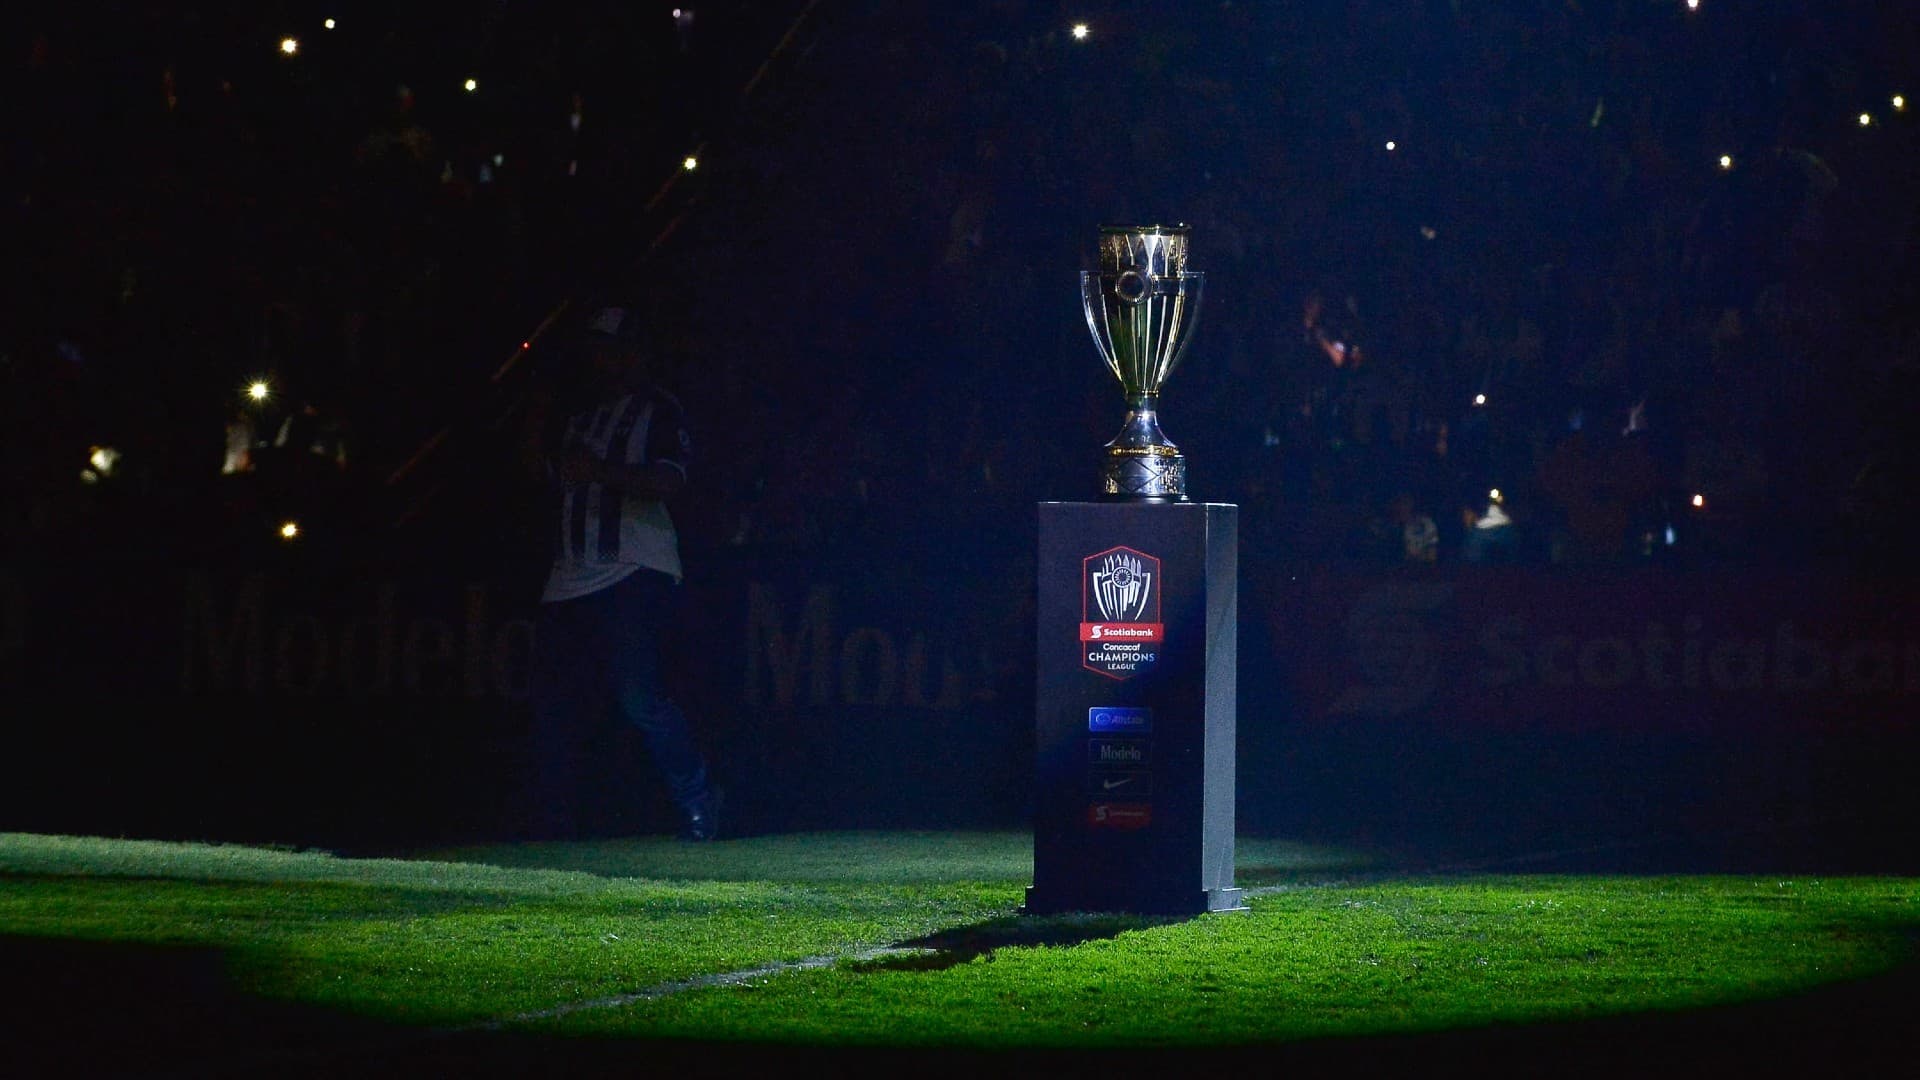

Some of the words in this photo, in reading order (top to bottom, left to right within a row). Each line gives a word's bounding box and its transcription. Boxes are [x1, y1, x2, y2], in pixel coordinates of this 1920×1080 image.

[1103, 628, 1154, 637] Scotiabank
[1102, 643, 1141, 651] Concacaf
[1088, 652, 1156, 662] CHAMPIONS
[1107, 663, 1136, 671] LEAGUE
